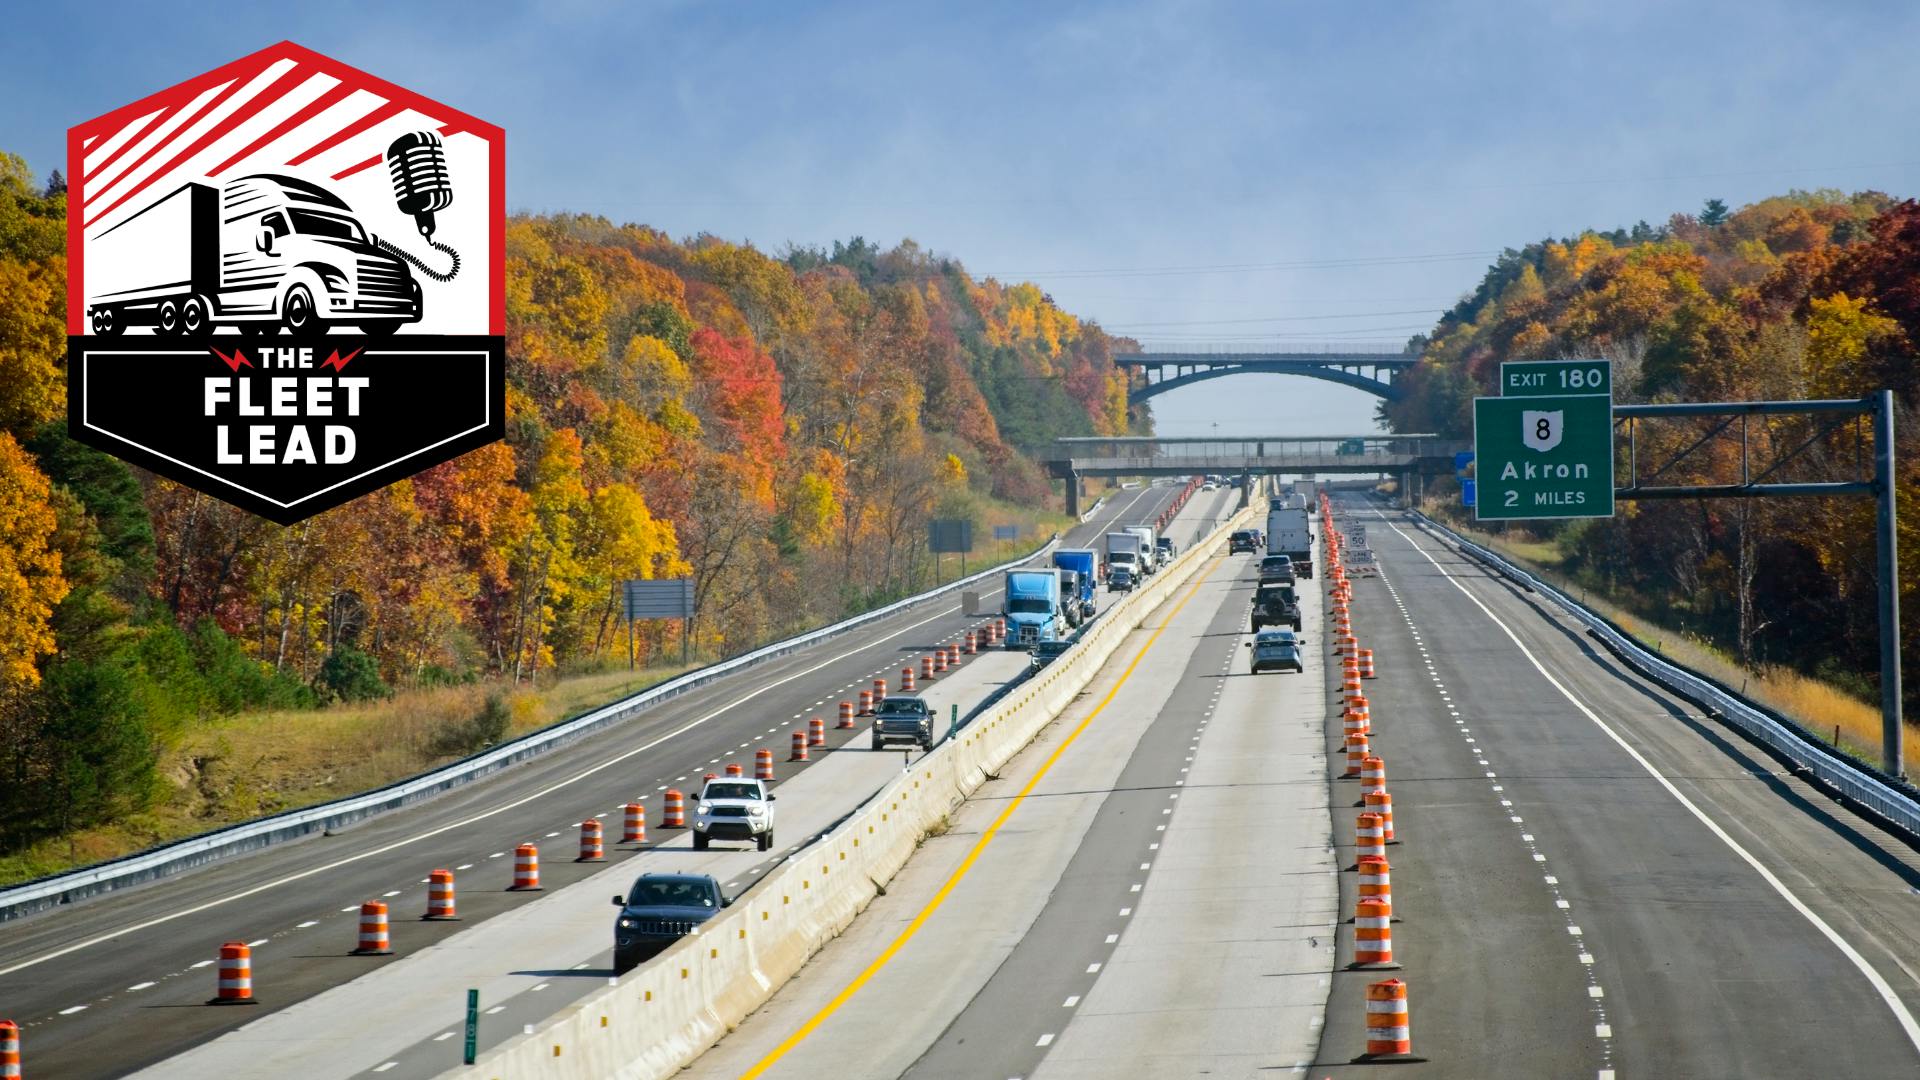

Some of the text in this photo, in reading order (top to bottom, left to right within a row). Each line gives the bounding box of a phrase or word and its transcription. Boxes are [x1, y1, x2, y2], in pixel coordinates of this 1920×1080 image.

[1510, 368, 1603, 388] EXIT 180
[1536, 418, 1551, 440] 8
[1501, 461, 1588, 481] Akron
[1504, 490, 1585, 507] 2 MILES
